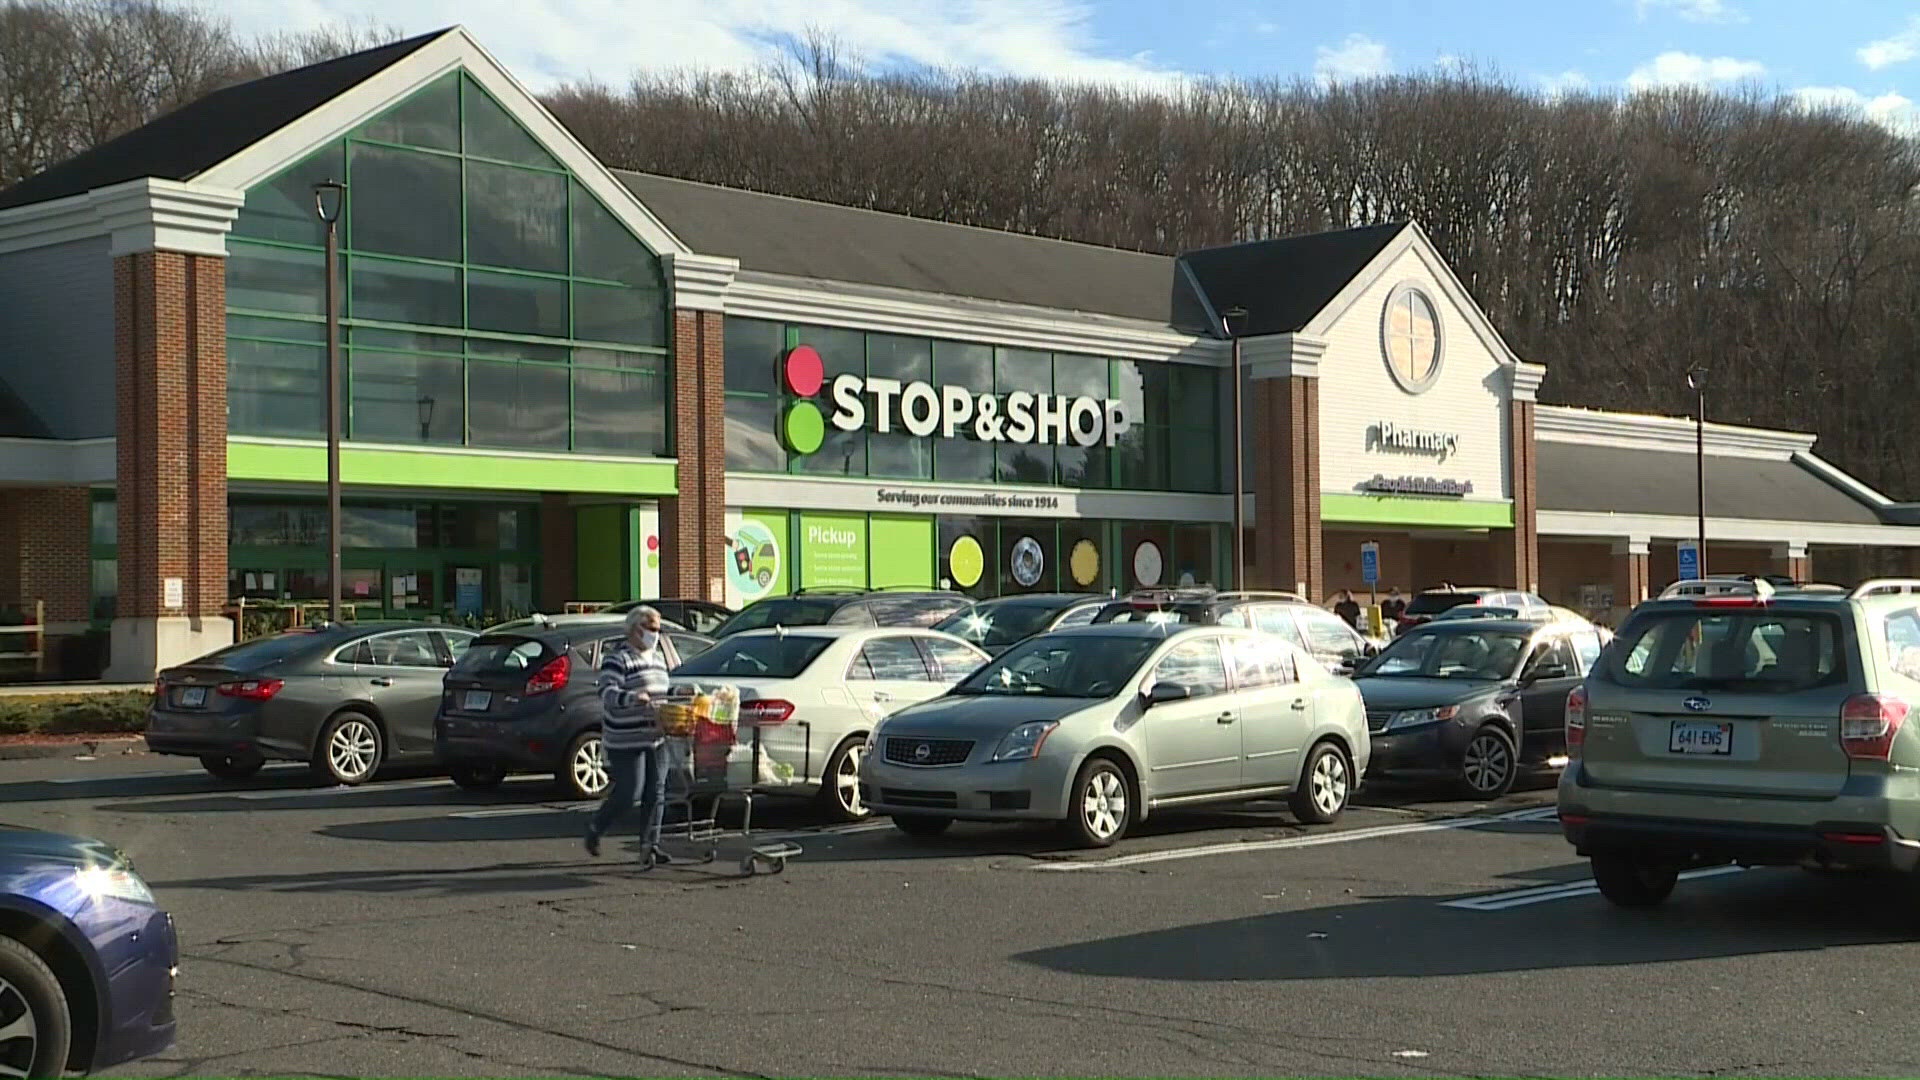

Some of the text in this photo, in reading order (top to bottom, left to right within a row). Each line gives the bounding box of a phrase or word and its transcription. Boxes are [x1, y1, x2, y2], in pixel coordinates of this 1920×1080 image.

[832, 373, 1131, 448] STOP&SHOP
[1380, 421, 1460, 456] Pharmacy
[877, 488, 1059, 509] Serving our communities since 1914
[808, 525, 857, 548] Pickup
